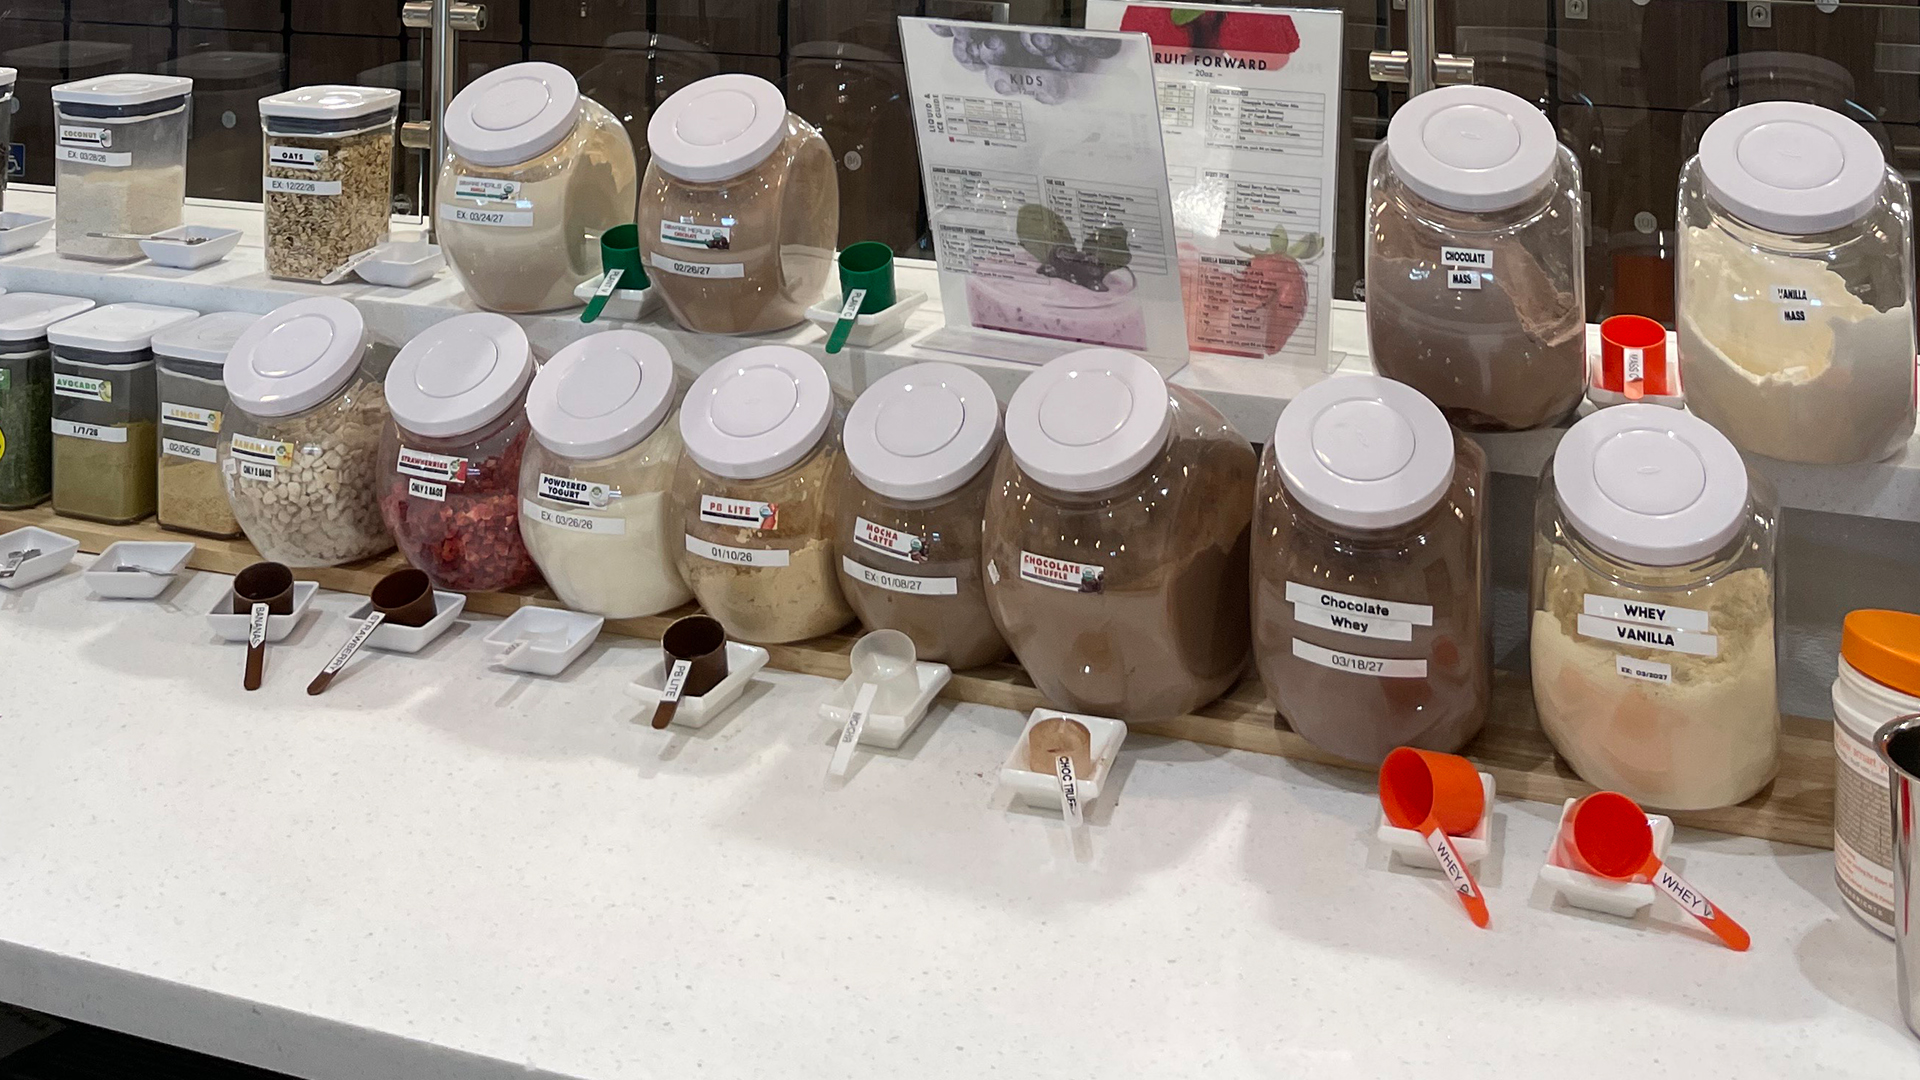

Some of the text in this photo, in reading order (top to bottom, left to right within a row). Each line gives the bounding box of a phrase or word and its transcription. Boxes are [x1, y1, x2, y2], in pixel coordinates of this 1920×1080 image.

[1153, 52, 1268, 72] RUIT FORWARD
[1009, 73, 1043, 87] KIDS
[925, 103, 937, 133] LIQUID
[932, 94, 945, 134] ICE GUIDE
[63, 130, 97, 139] COCONUT
[281, 152, 304, 160] OATS
[286, 182, 316, 192] 12/22/26
[469, 212, 504, 224] 03/24/27
[1445, 251, 1486, 264] CHOCOLATE
[1452, 274, 1472, 284] MASS
[1777, 288, 1808, 301] VANILLA
[1784, 310, 1806, 321] MASS
[56, 378, 98, 391] AVOCADO
[170, 408, 201, 420] LEMON
[169, 442, 201, 456] 02/05/26
[234, 438, 275, 454] BANANAS
[400, 455, 449, 470] STRAWBERRIES
[243, 465, 254, 475] ONLY
[259, 467, 272, 478] BAGS
[411, 482, 424, 494] ONLY
[429, 486, 444, 498] BAGS
[542, 476, 588, 492] POWDERED
[547, 486, 580, 499] YOGURT
[709, 502, 751, 516] PB LITE
[540, 511, 593, 530] EX: 03/26/26
[866, 523, 899, 541] MOCHA
[868, 532, 894, 547] LATTE
[711, 547, 753, 562] 01/10/26
[1024, 554, 1081, 575] CHOCOLATE
[1033, 566, 1069, 581] TRUFFLE
[880, 575, 922, 592] 01/08/27
[1320, 594, 1390, 617] Chocolate
[1623, 603, 1666, 621] WHEY
[252, 606, 266, 646] BANANAS
[1330, 614, 1369, 633] Whey
[329, 614, 380, 671] STRAWBERRY
[1616, 626, 1675, 646] VANILLA
[1331, 654, 1384, 673] 03/18/27
[665, 665, 686, 698] PB LITE
[1059, 755, 1073, 782] CHOC
[1437, 841, 1464, 882] WHEY
[1662, 872, 1702, 908] WHEY
